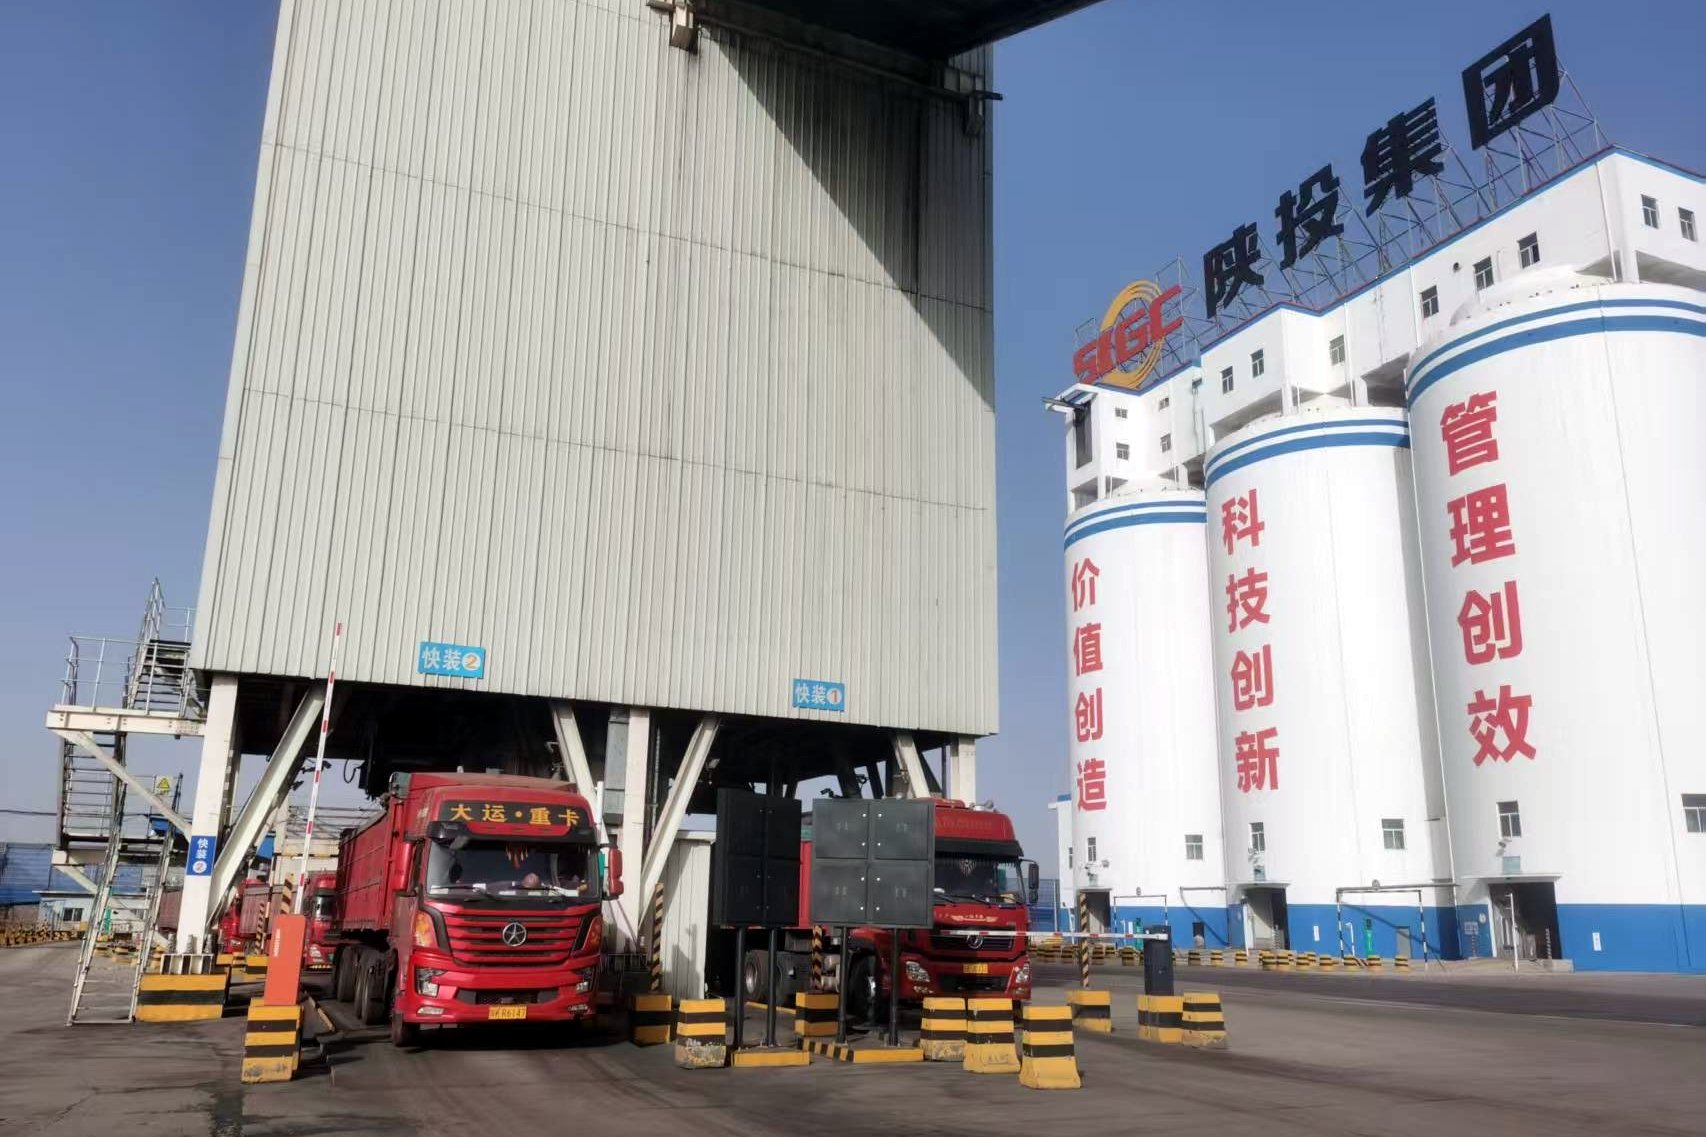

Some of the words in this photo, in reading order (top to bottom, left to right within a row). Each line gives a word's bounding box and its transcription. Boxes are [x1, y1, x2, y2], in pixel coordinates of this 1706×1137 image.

[1203, 13, 1560, 319] 陕投集团
[1071, 556, 1107, 812] 价值创造
[1221, 488, 1280, 793] 科技创新
[1440, 390, 1536, 767] 管理创效
